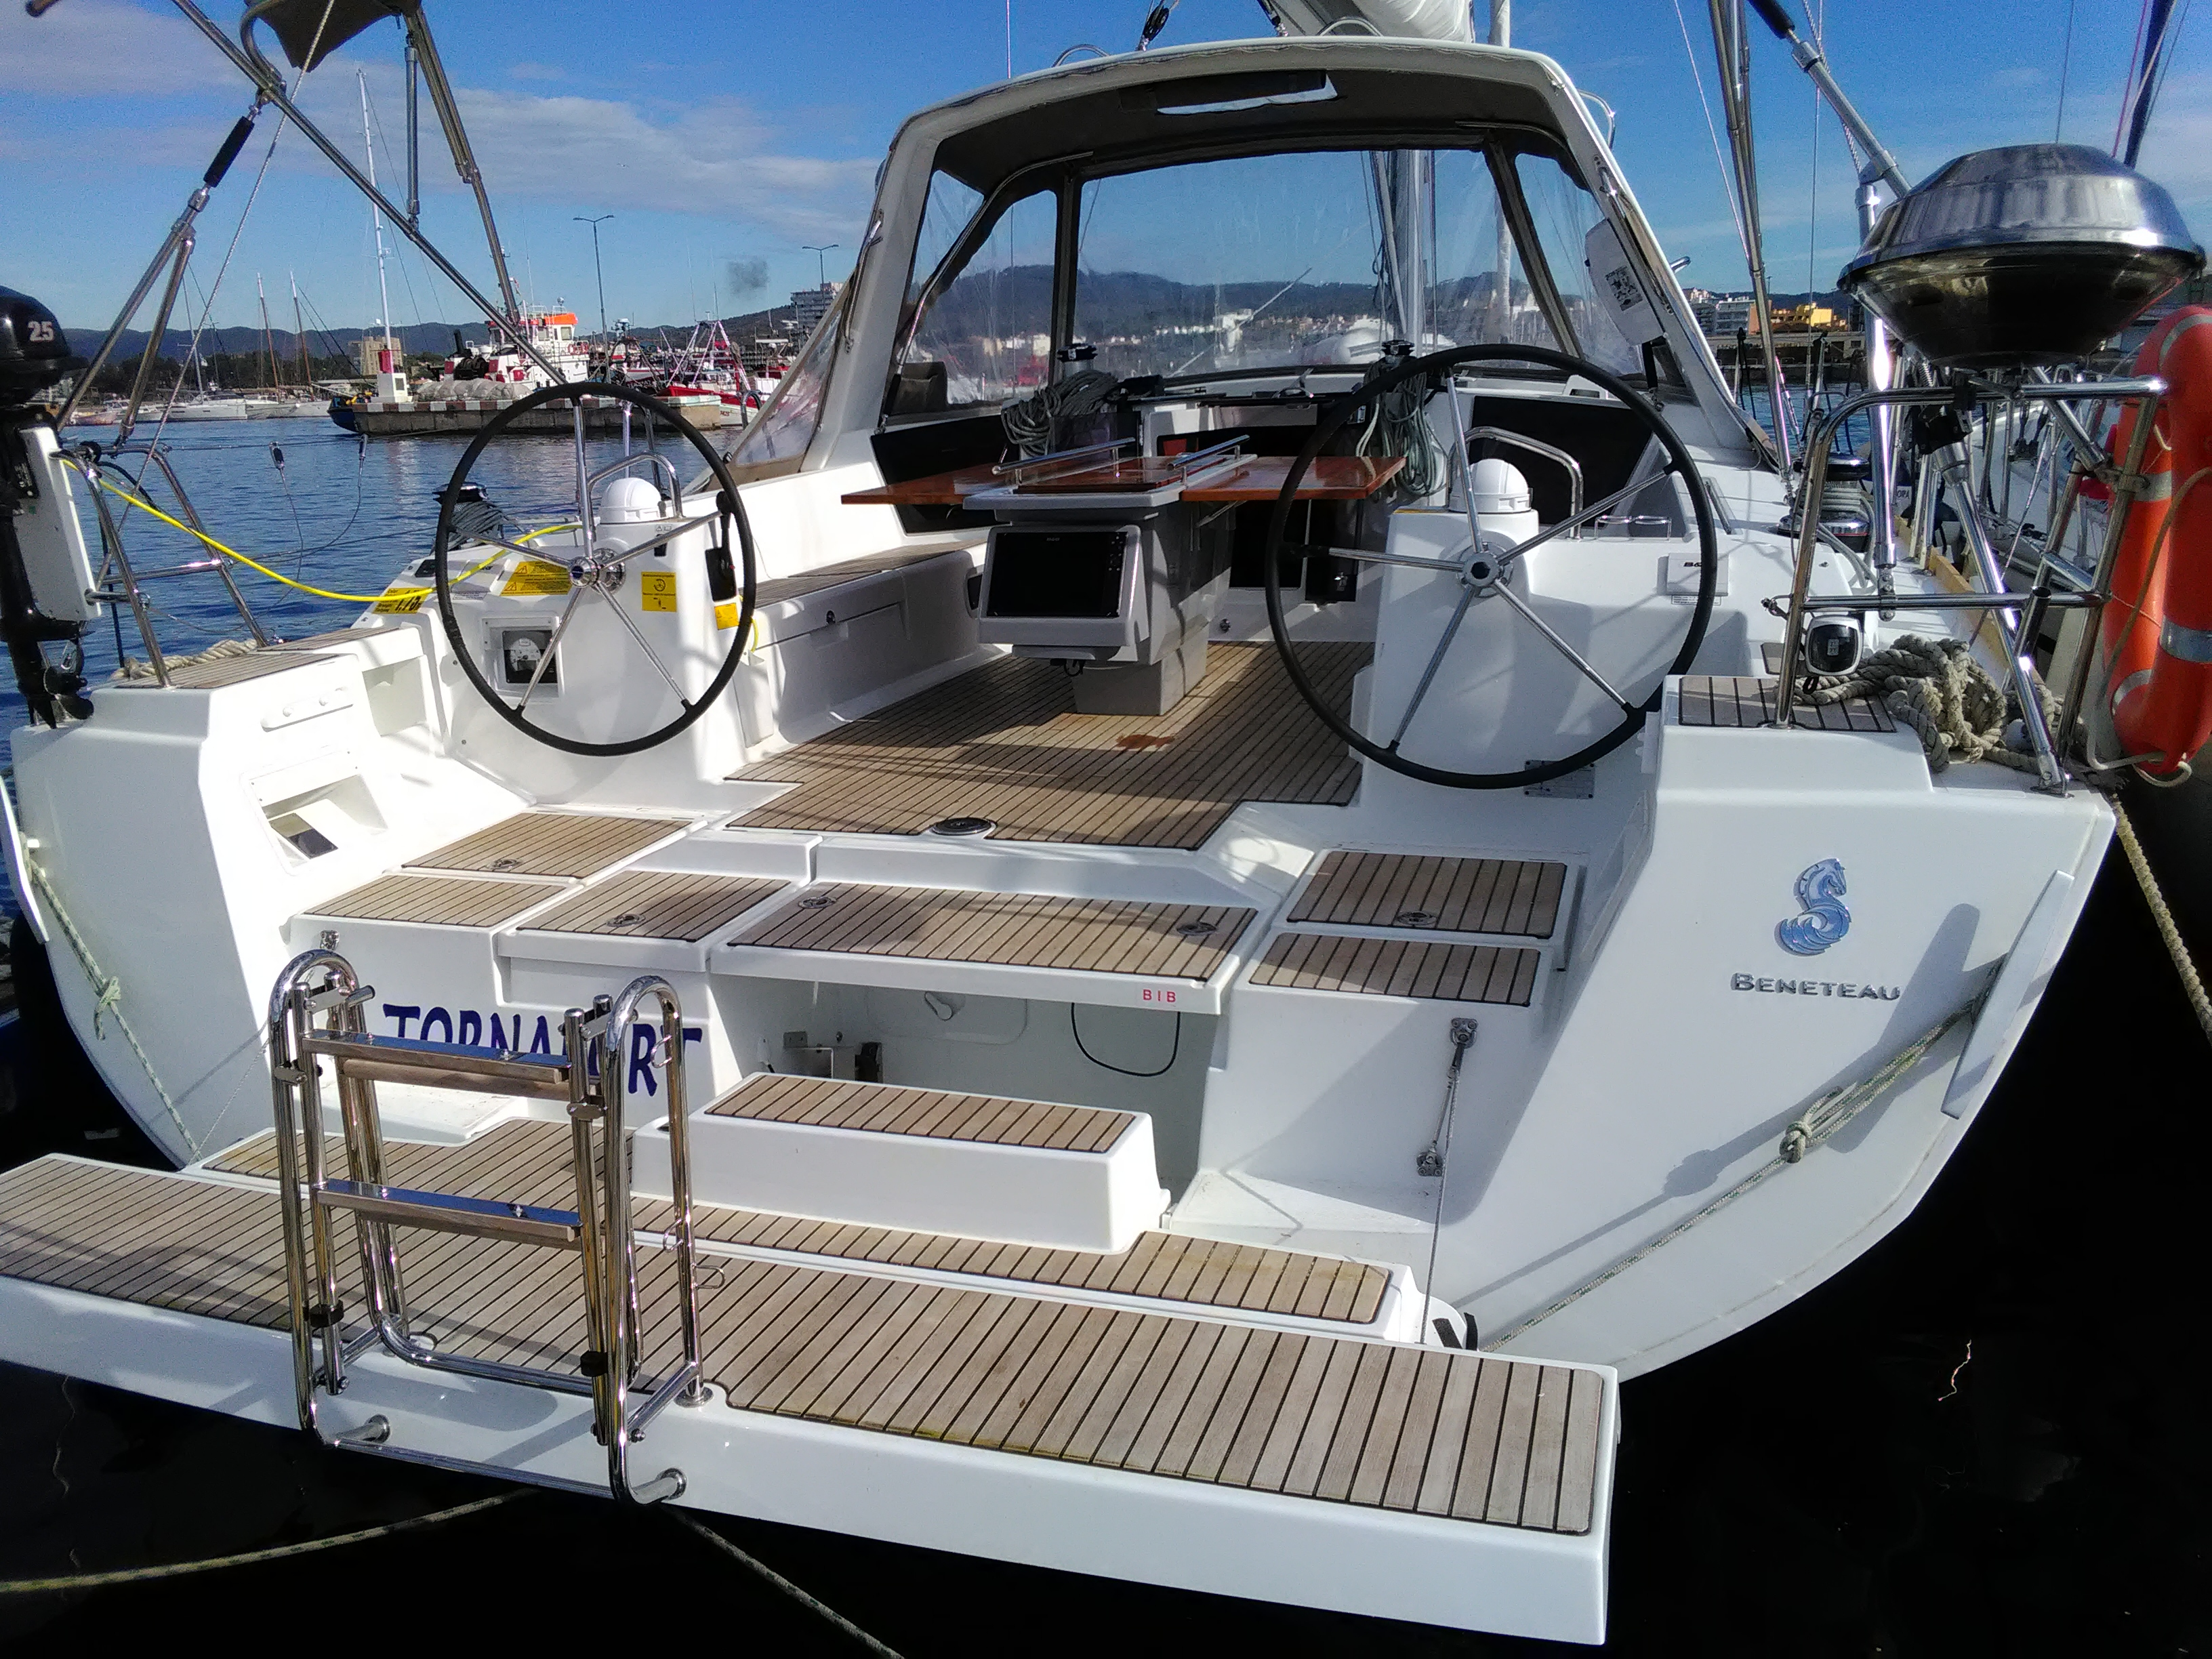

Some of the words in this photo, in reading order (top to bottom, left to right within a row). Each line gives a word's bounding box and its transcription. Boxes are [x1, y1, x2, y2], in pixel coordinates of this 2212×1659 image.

[28, 321, 54, 342] 25
[1143, 989, 1176, 1003] BIB
[1730, 972, 1900, 1001] BENETEAU
